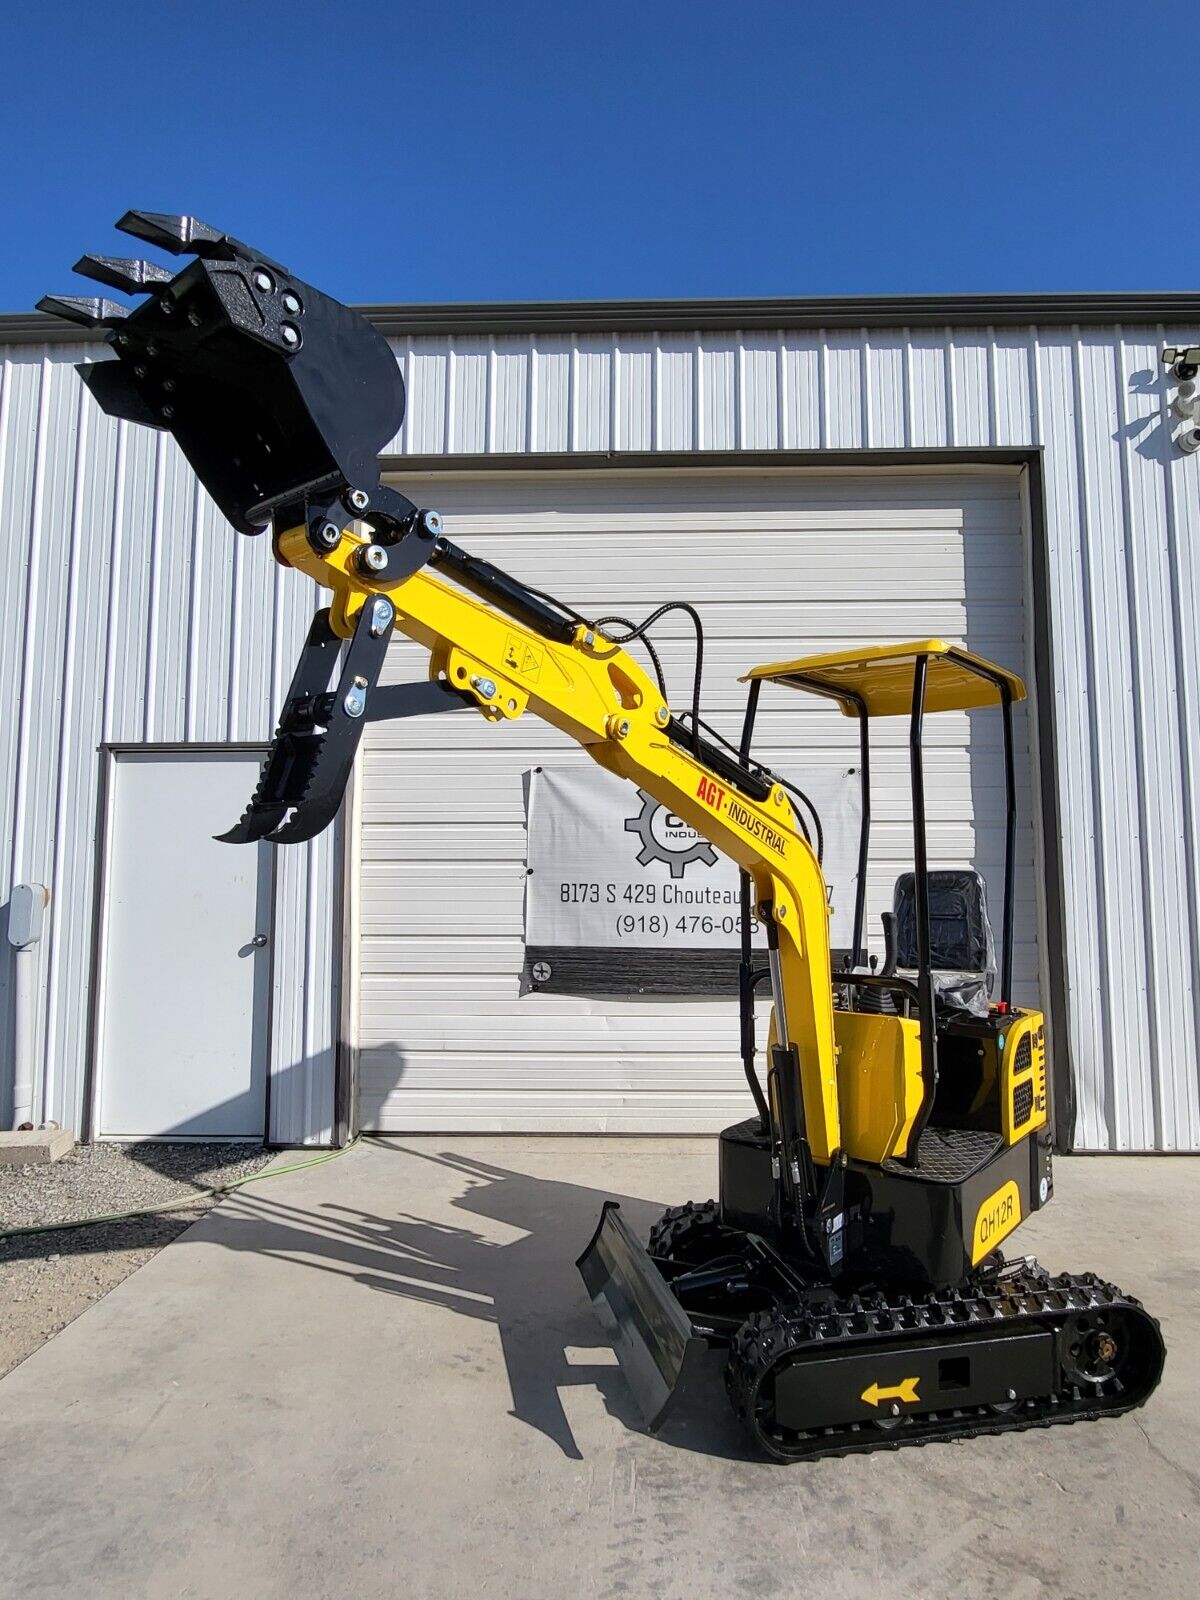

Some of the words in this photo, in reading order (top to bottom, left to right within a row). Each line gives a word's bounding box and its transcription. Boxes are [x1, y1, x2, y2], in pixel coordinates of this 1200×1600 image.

[696, 775, 725, 811] AGT
[728, 801, 785, 855] INDUSTRIAL
[560, 883, 599, 903] 8173
[606, 884, 616, 903] S
[623, 884, 656, 904] 429
[663, 884, 742, 904] Chouteau
[616, 914, 668, 938] (918)
[675, 915, 760, 934] 476-058
[980, 1194, 1013, 1243] QH12R
